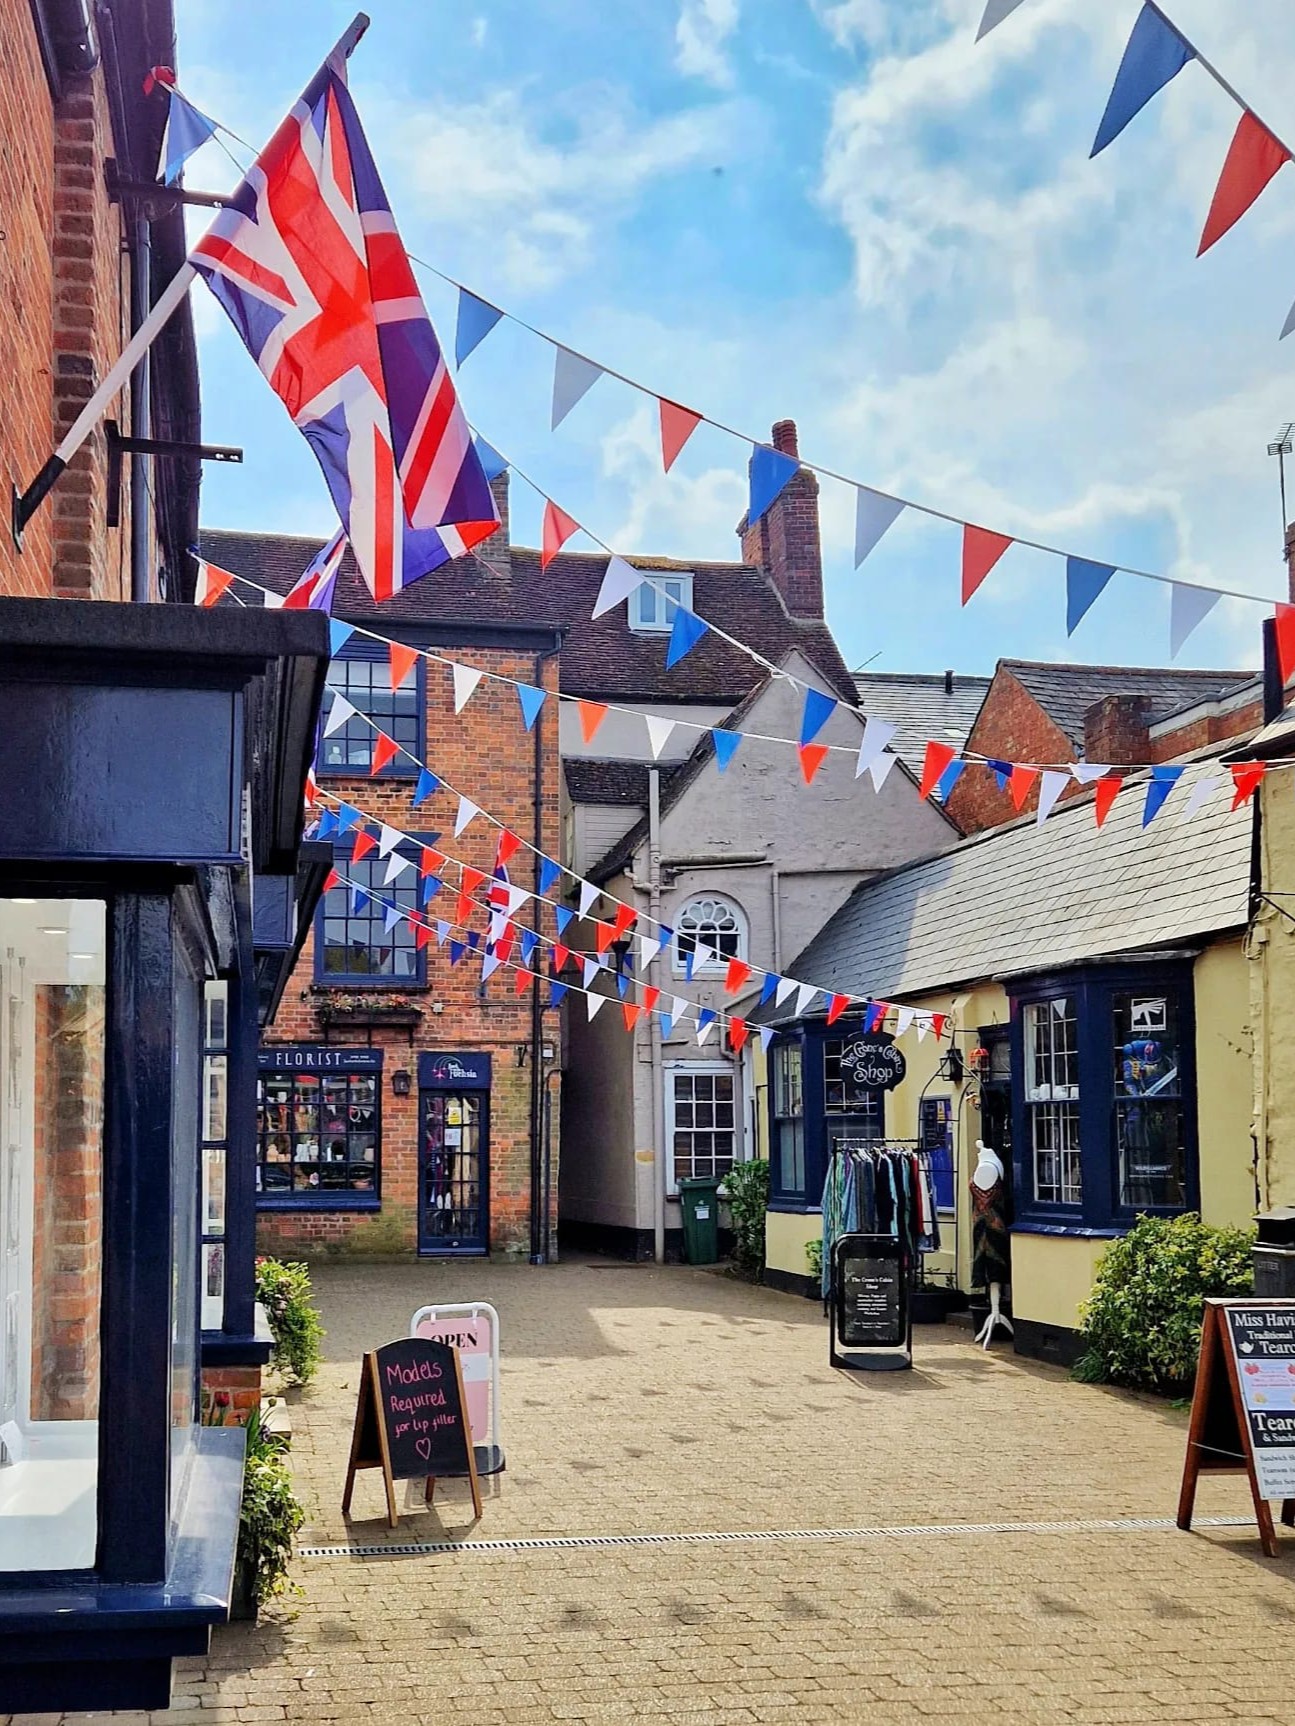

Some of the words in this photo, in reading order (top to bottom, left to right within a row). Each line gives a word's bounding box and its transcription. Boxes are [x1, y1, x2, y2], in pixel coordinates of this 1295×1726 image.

[276, 1052, 342, 1066] FLORIST
[840, 1053, 859, 1069] The
[853, 1055, 893, 1086] Shop
[1234, 1313, 1264, 1327] Miss
[1247, 1331, 1293, 1340] Traditional
[386, 1360, 443, 1386] Models
[390, 1388, 447, 1415] Required
[395, 1422, 410, 1438] for
[413, 1419, 429, 1433] lip
[432, 1414, 457, 1431] filler
[1251, 1412, 1295, 1431] Tear
[1262, 1432, 1272, 1442] &
